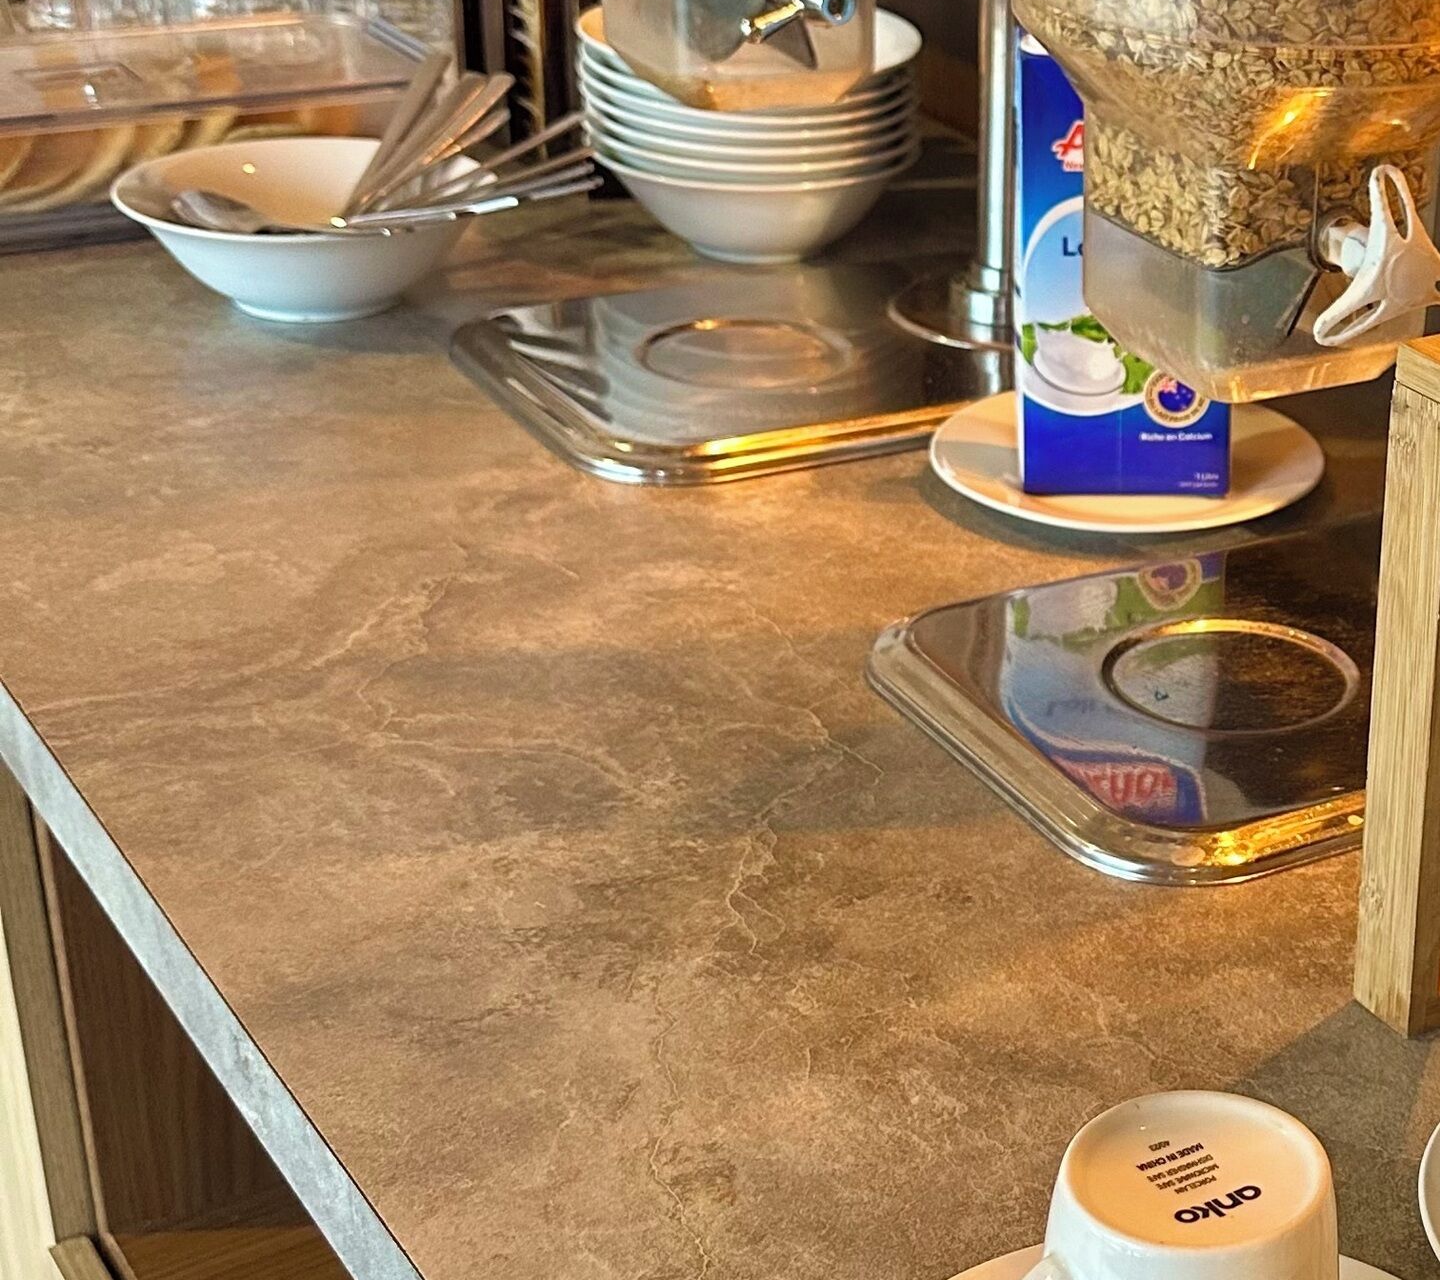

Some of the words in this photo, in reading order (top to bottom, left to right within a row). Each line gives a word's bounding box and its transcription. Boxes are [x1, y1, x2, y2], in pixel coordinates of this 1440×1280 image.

[1165, 1152, 1178, 1162] IN
[1176, 1142, 1204, 1158] MADE
[1135, 1157, 1167, 1171] CHINA
[1174, 1185, 1261, 1223] anko
